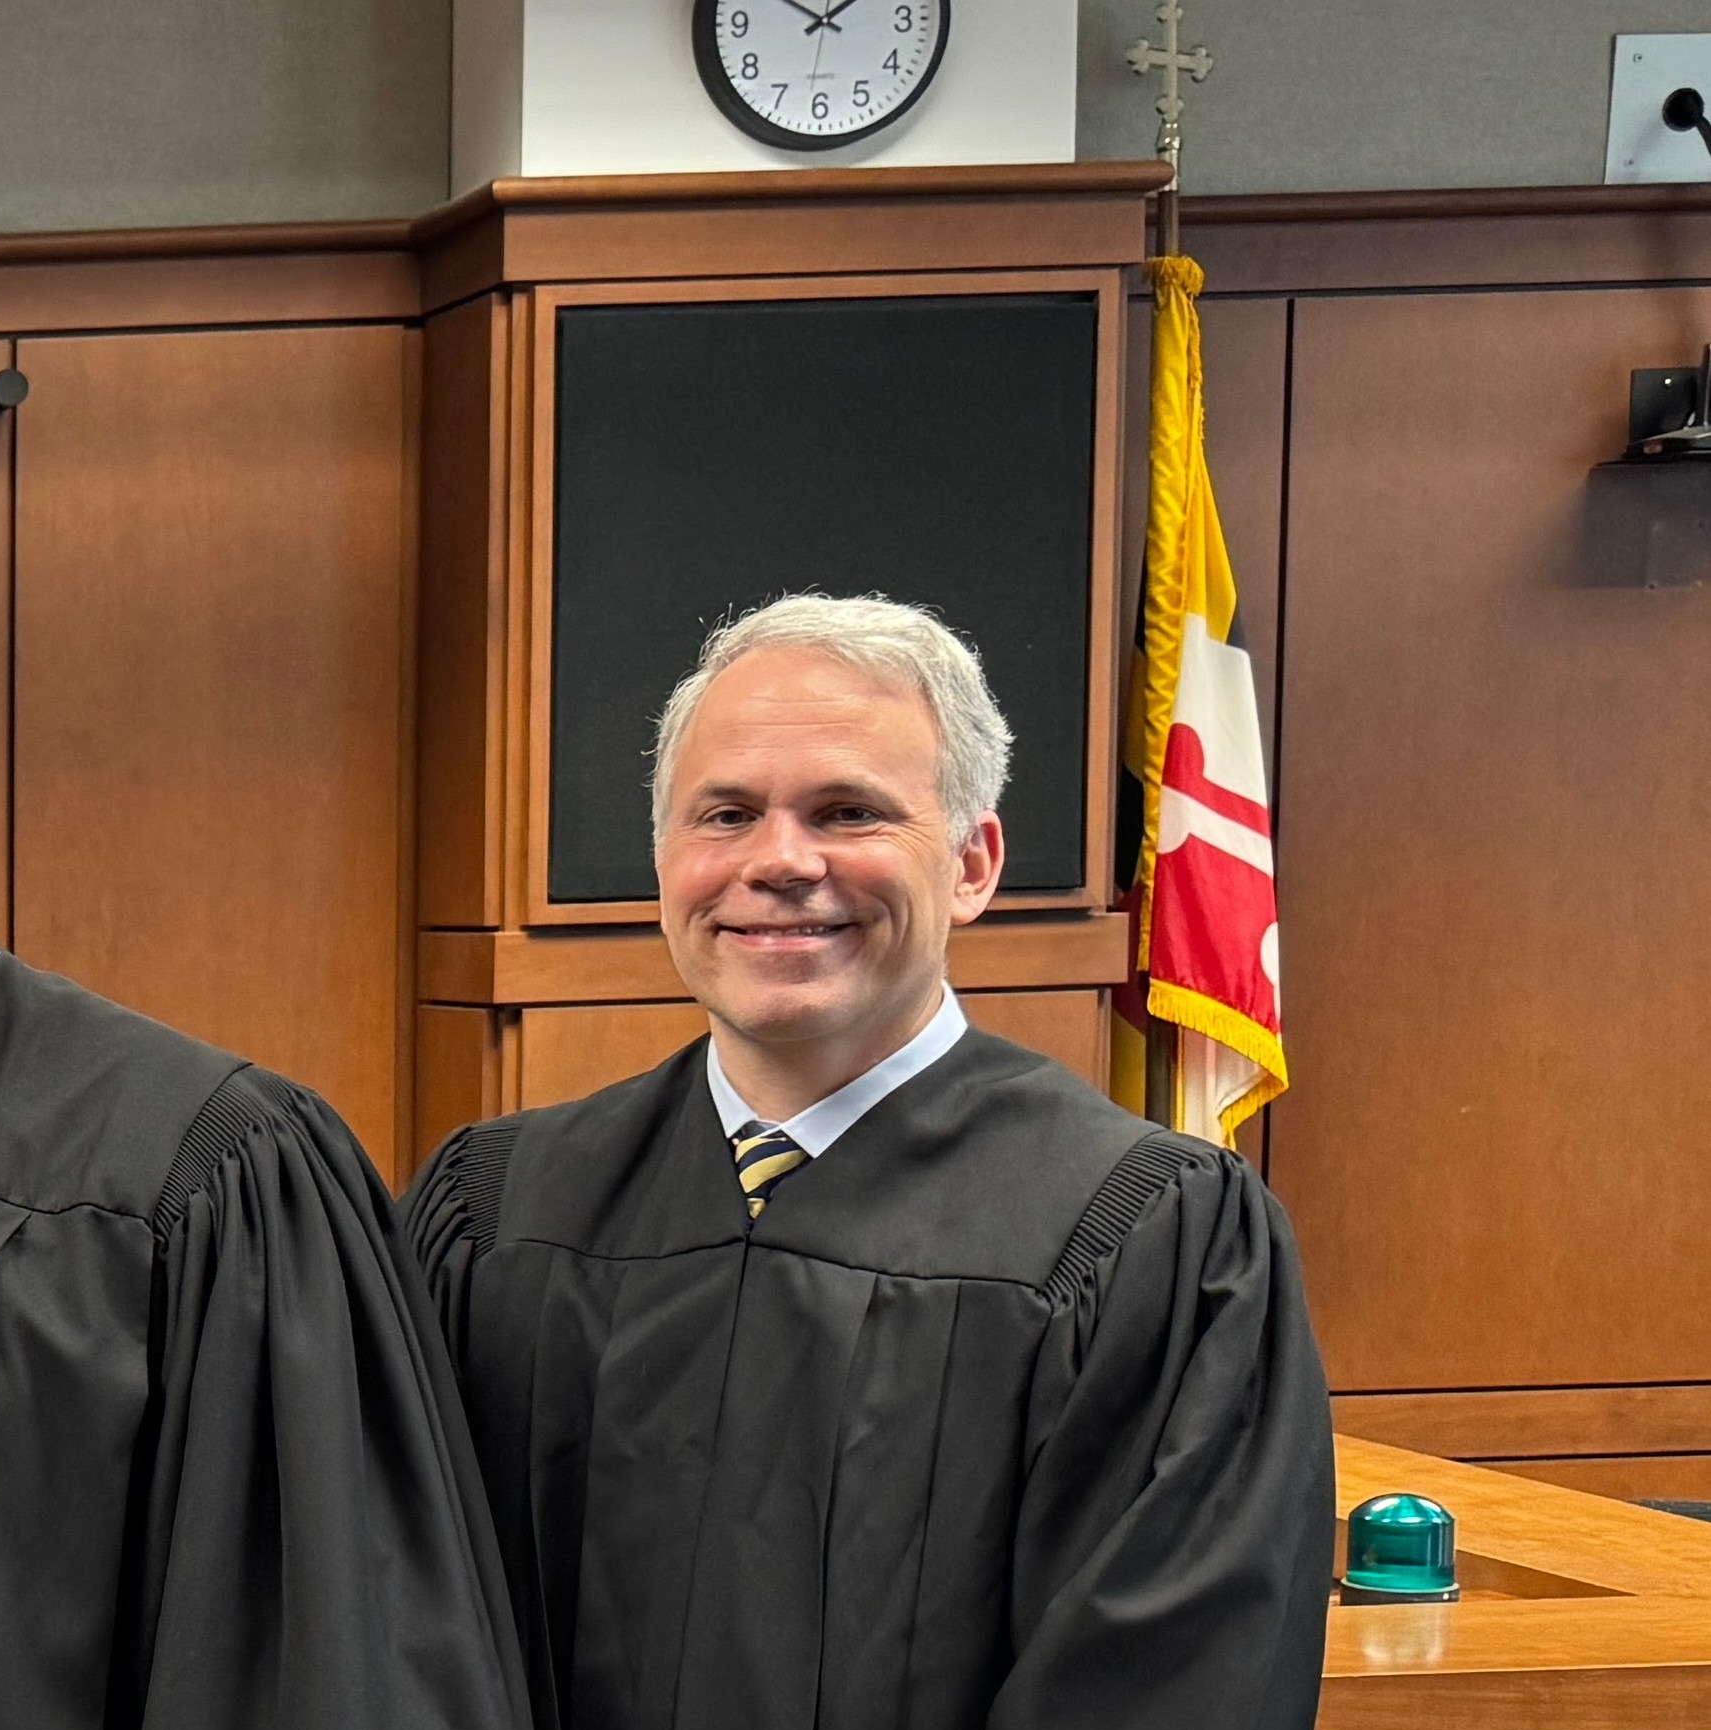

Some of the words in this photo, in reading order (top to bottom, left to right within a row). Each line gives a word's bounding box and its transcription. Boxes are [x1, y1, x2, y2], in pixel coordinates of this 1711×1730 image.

[731, 10, 749, 38] 9
[894, 5, 913, 33] 3
[741, 53, 759, 80] 8
[882, 48, 901, 75] 4
[771, 83, 789, 110] 7
[811, 92, 829, 120] 6
[852, 80, 870, 107] 5
